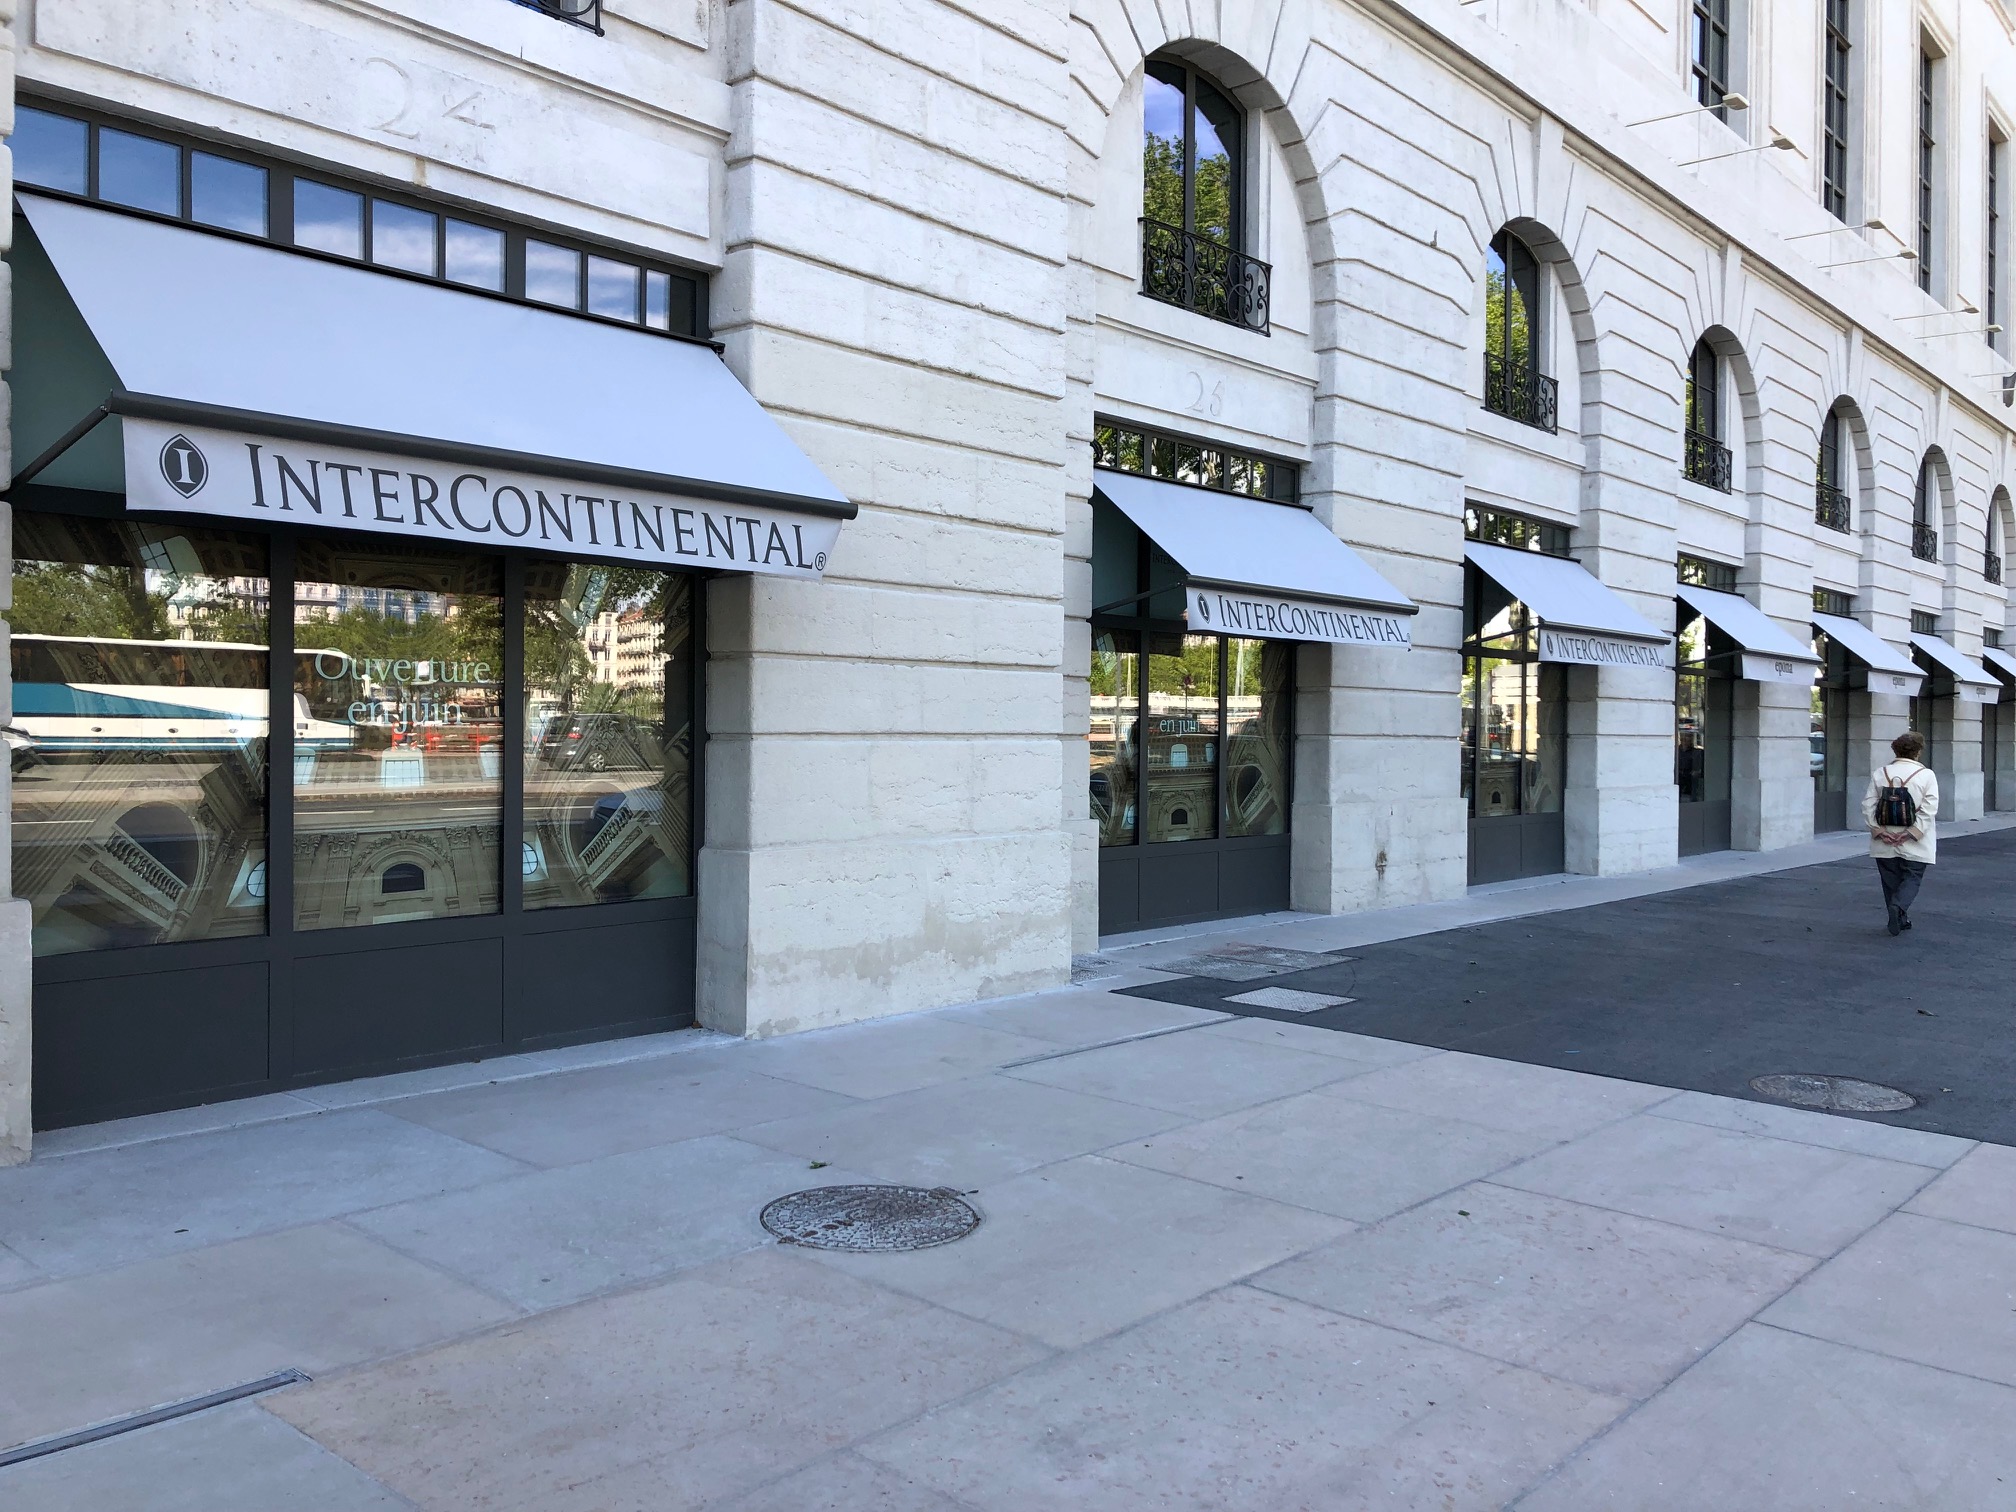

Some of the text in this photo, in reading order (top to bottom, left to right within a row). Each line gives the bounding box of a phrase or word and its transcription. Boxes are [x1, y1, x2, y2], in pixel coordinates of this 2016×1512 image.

[361, 56, 497, 164] 24
[314, 647, 491, 684] Ouverture
[347, 692, 463, 734] en juin
[1159, 718, 1176, 733] en
